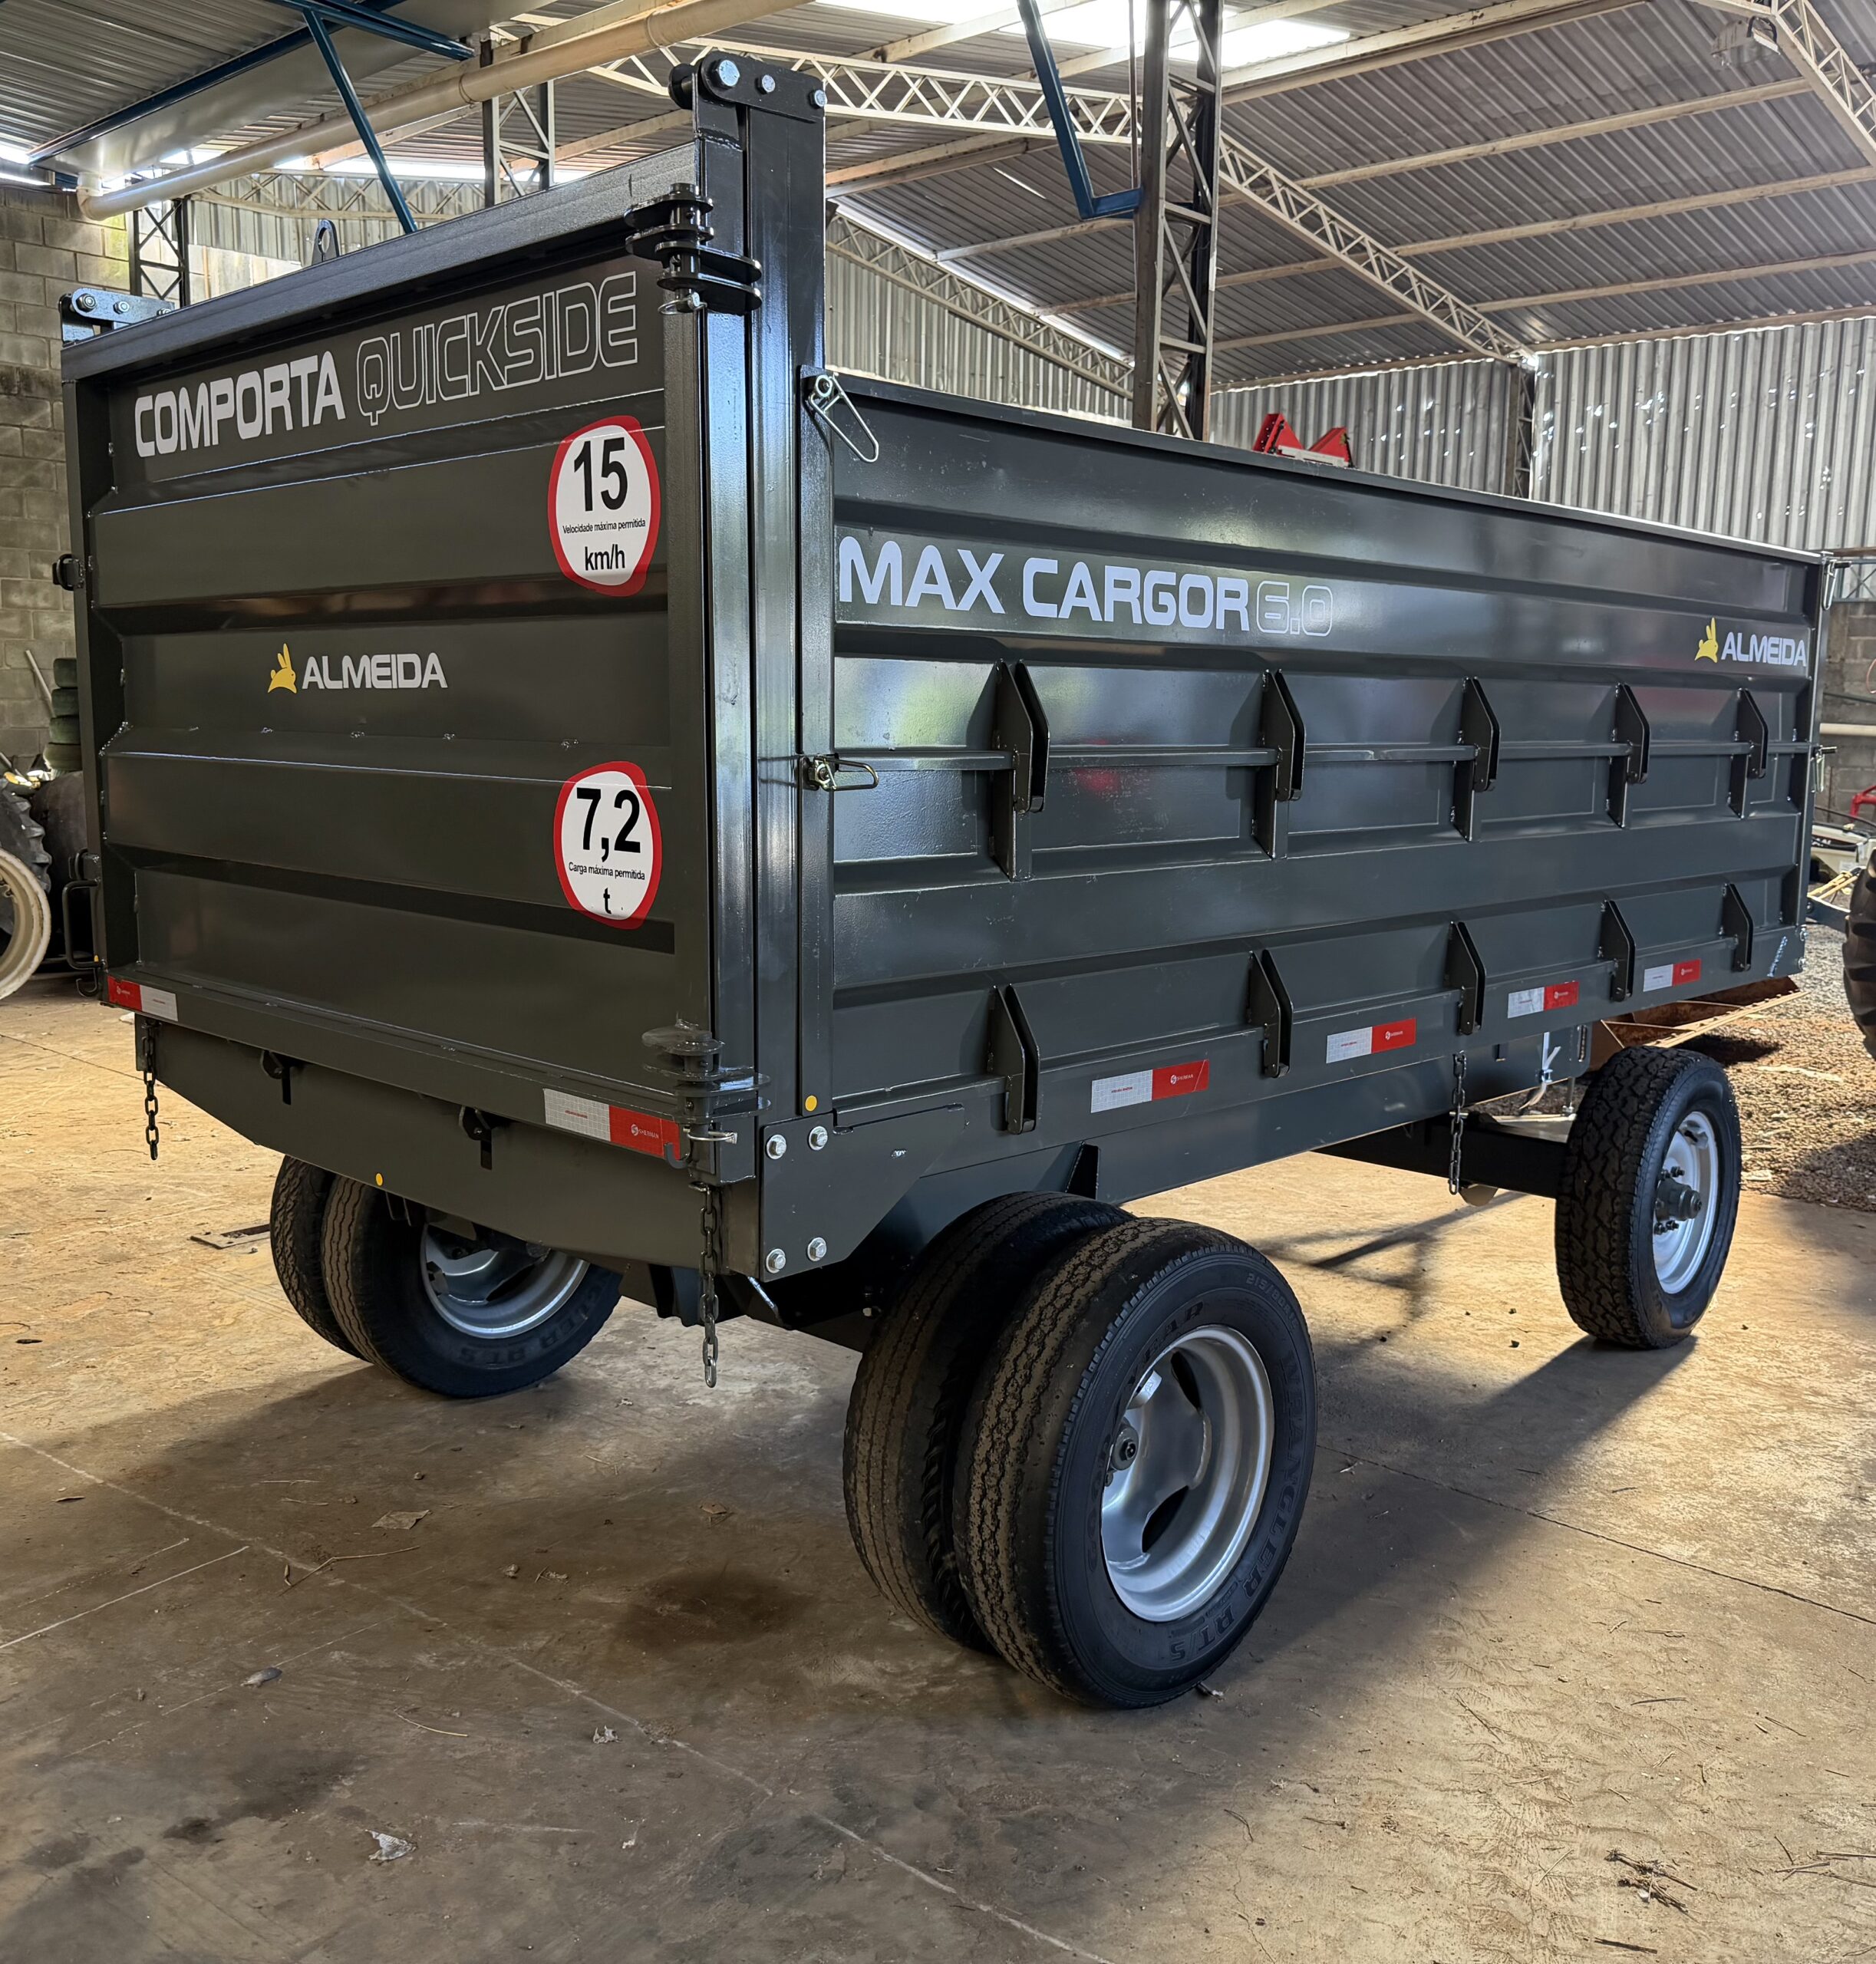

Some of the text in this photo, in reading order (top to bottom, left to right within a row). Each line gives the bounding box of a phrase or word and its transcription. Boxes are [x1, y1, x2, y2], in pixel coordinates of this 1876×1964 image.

[134, 271, 638, 457] COMPORTA QUICKSIDE
[574, 437, 628, 512] 15
[562, 518, 646, 534] Velocidade máxima permitida
[585, 544, 625, 571] km/h
[839, 536, 1334, 637] MAX CARGOR 6.0
[1721, 631, 1807, 667] ALMEIDA
[302, 652, 448, 690] ALMEIDA
[576, 787, 641, 862] 7,2
[569, 862, 645, 880] Carga máxima permitida
[603, 887, 612, 914] t
